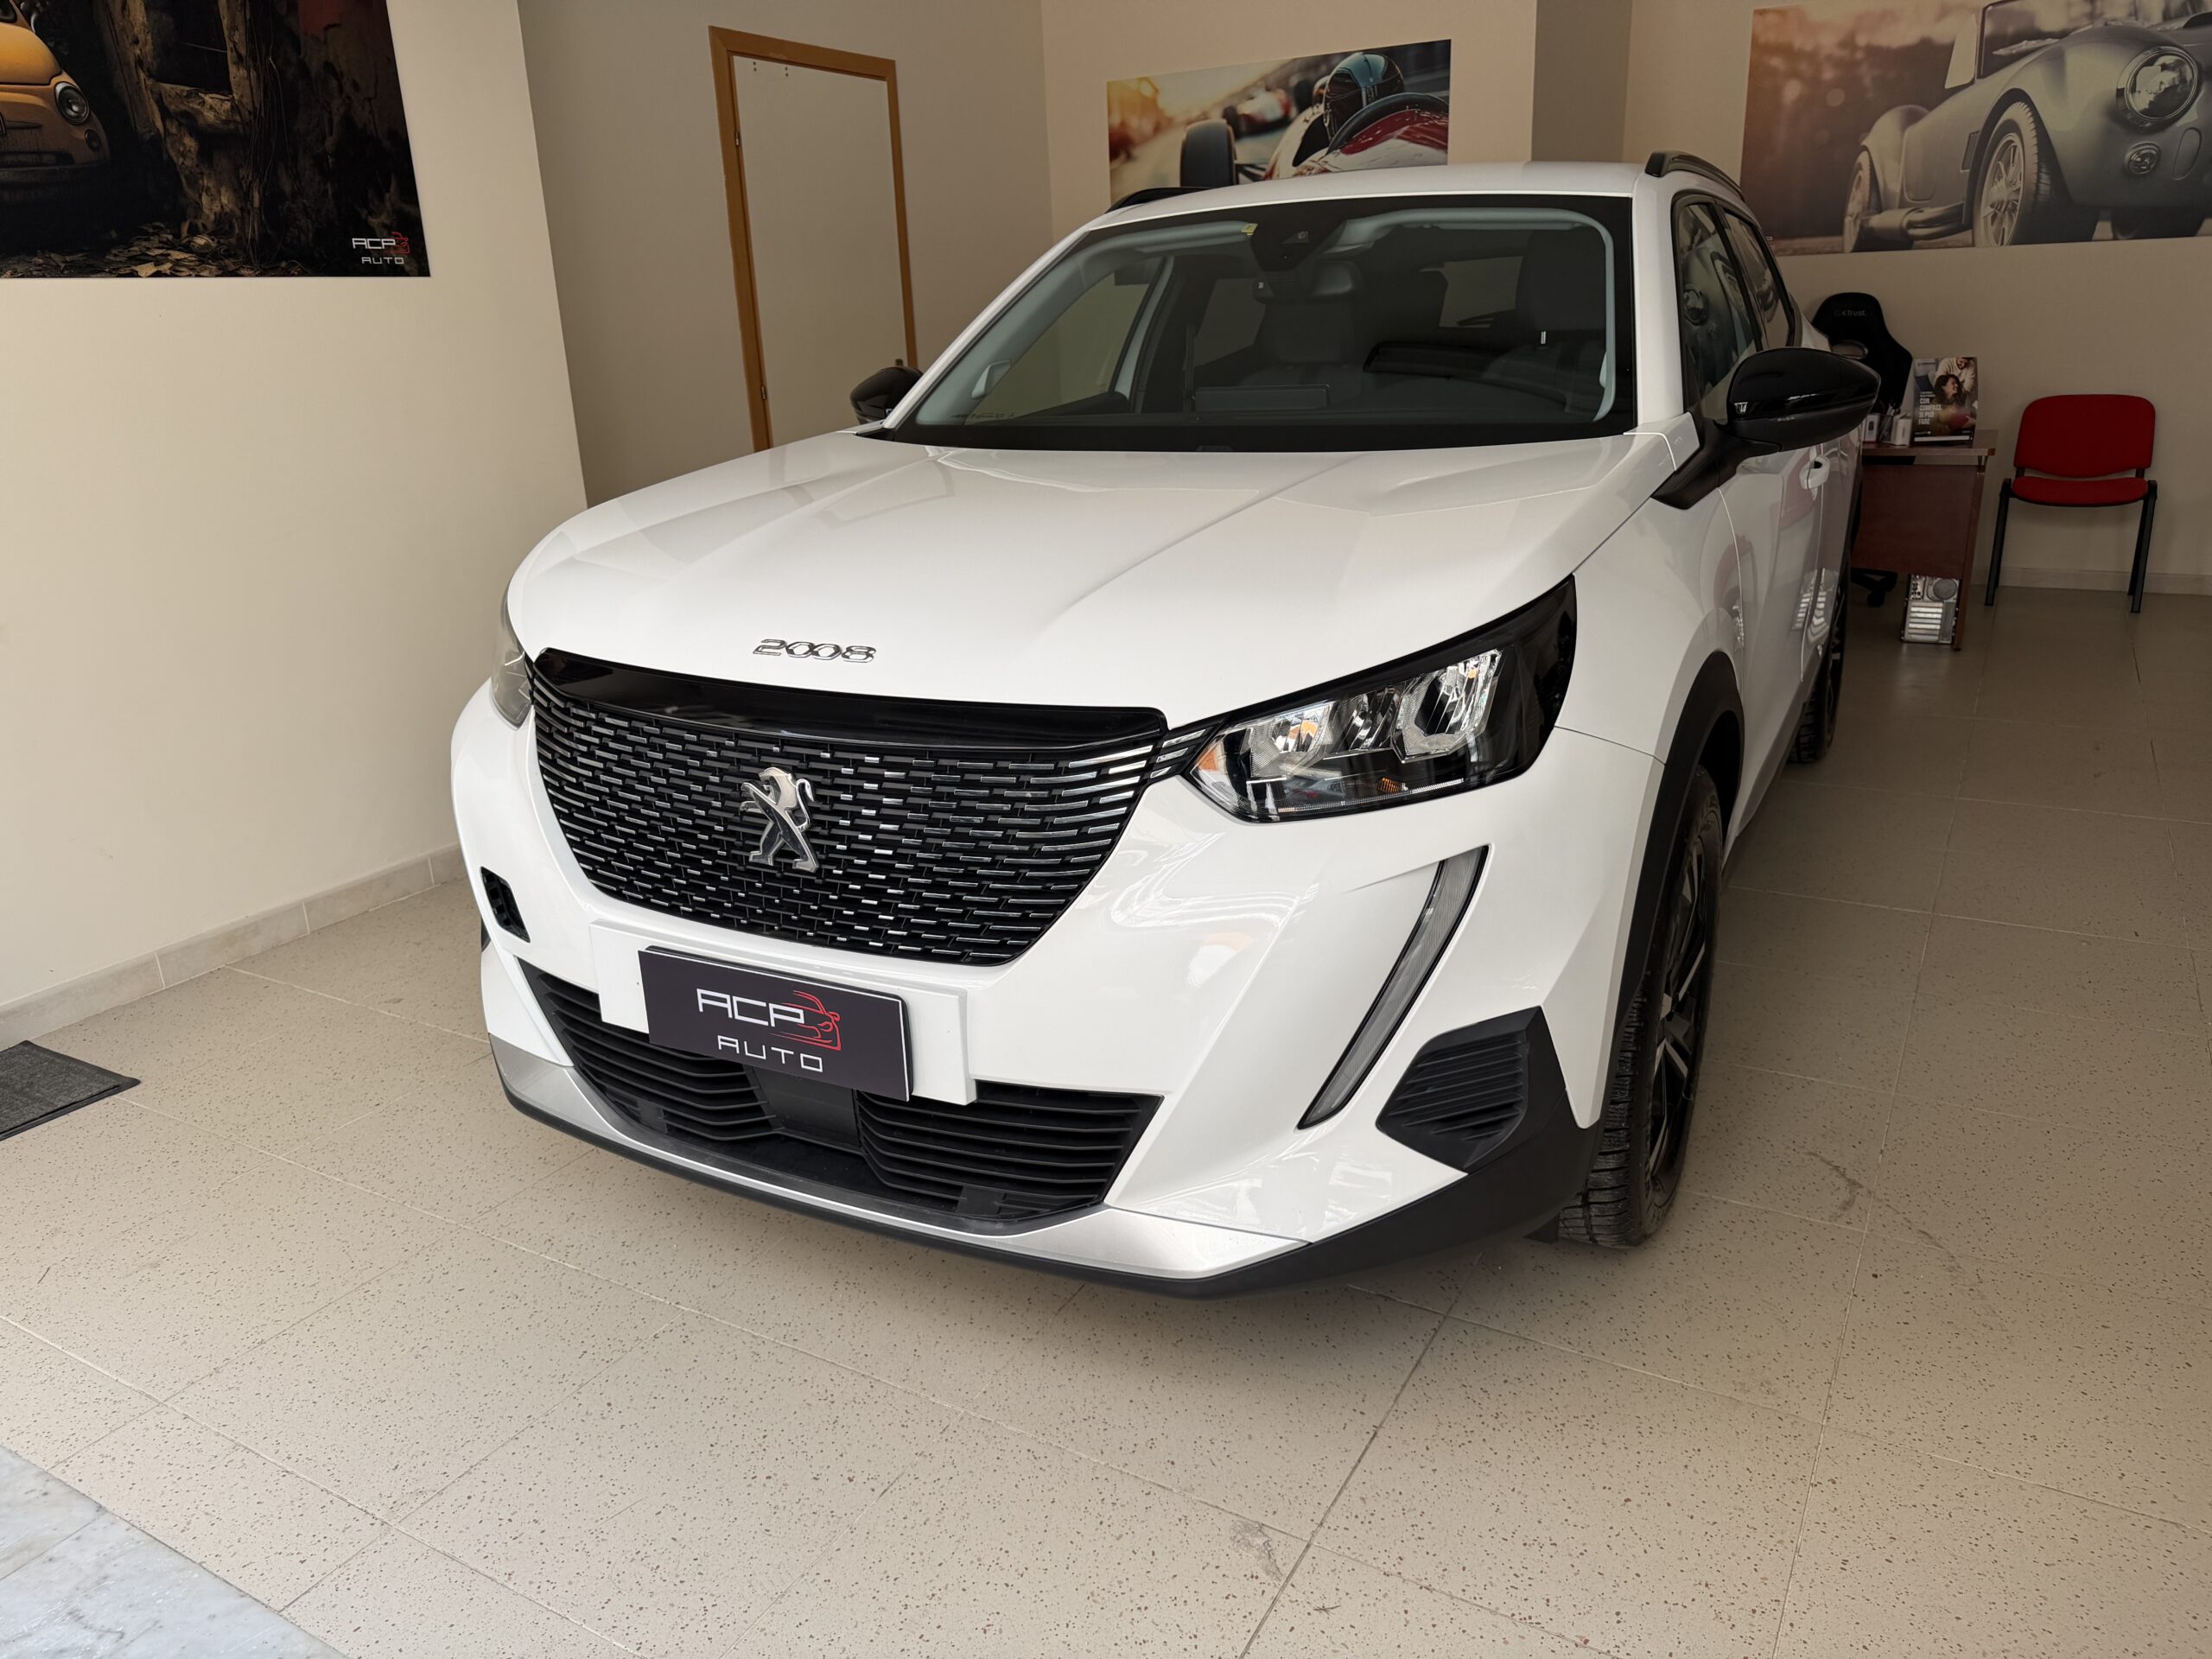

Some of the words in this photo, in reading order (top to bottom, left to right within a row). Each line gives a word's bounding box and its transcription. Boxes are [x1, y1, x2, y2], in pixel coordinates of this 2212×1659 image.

[352, 238, 396, 249] ACP
[753, 639, 877, 664] 2008
[696, 988, 804, 1027] ACP
[717, 1035, 823, 1072] AUTO
